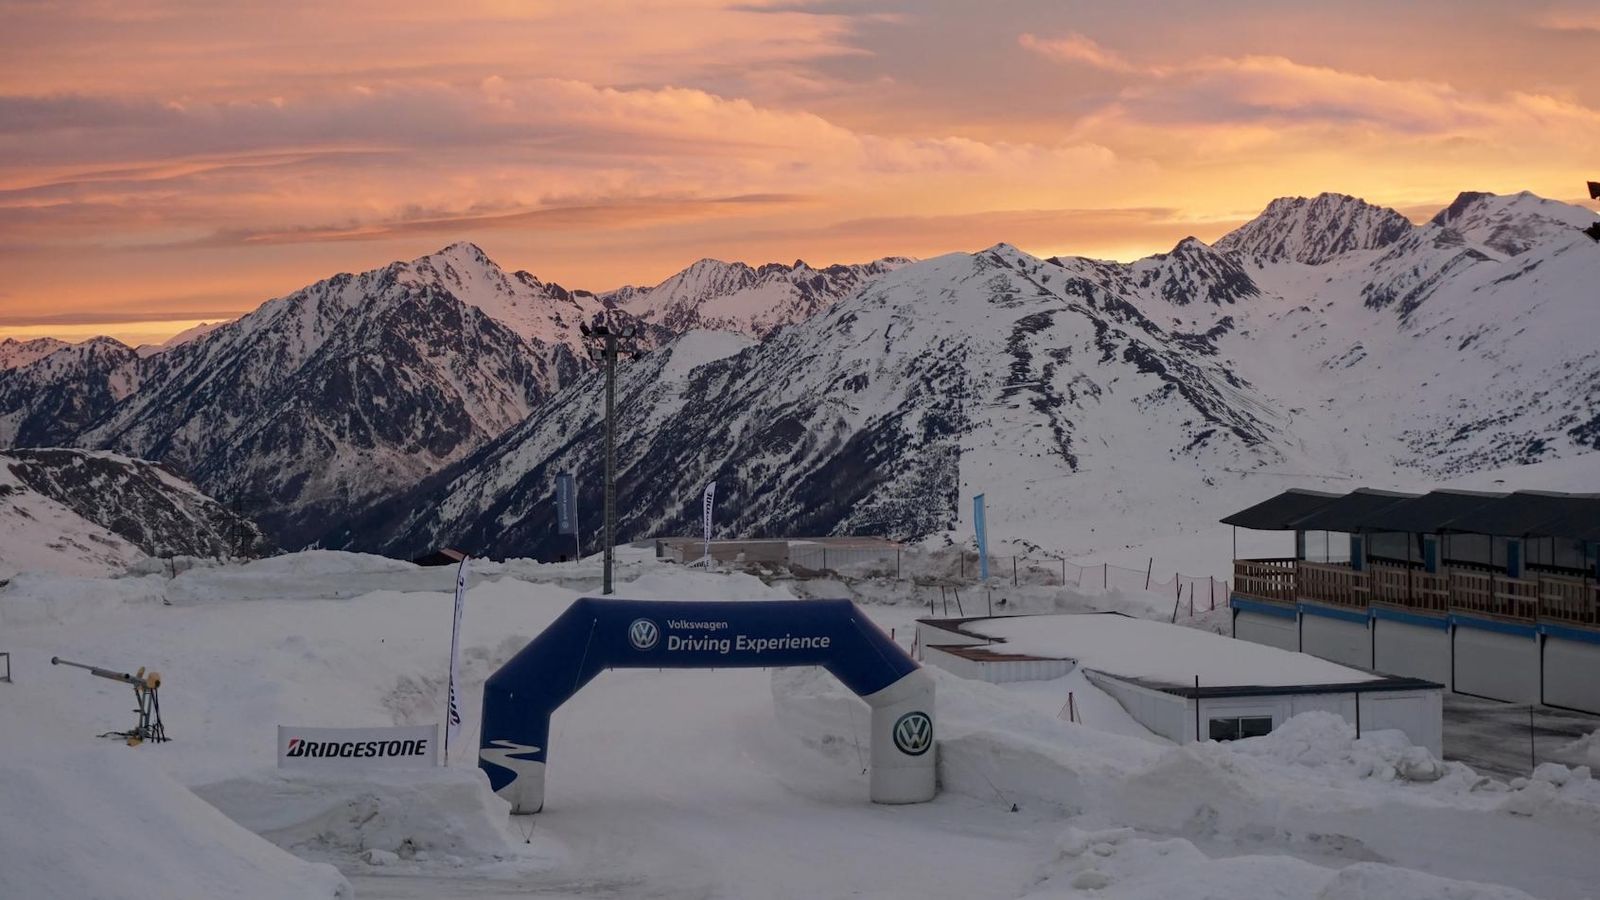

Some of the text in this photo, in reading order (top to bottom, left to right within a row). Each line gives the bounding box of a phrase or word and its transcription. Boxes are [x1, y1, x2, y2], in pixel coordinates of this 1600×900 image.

[667, 619, 729, 631] Volkswagen
[667, 633, 831, 654] Driving Experience
[286, 737, 428, 758] BRIDGESTONE
